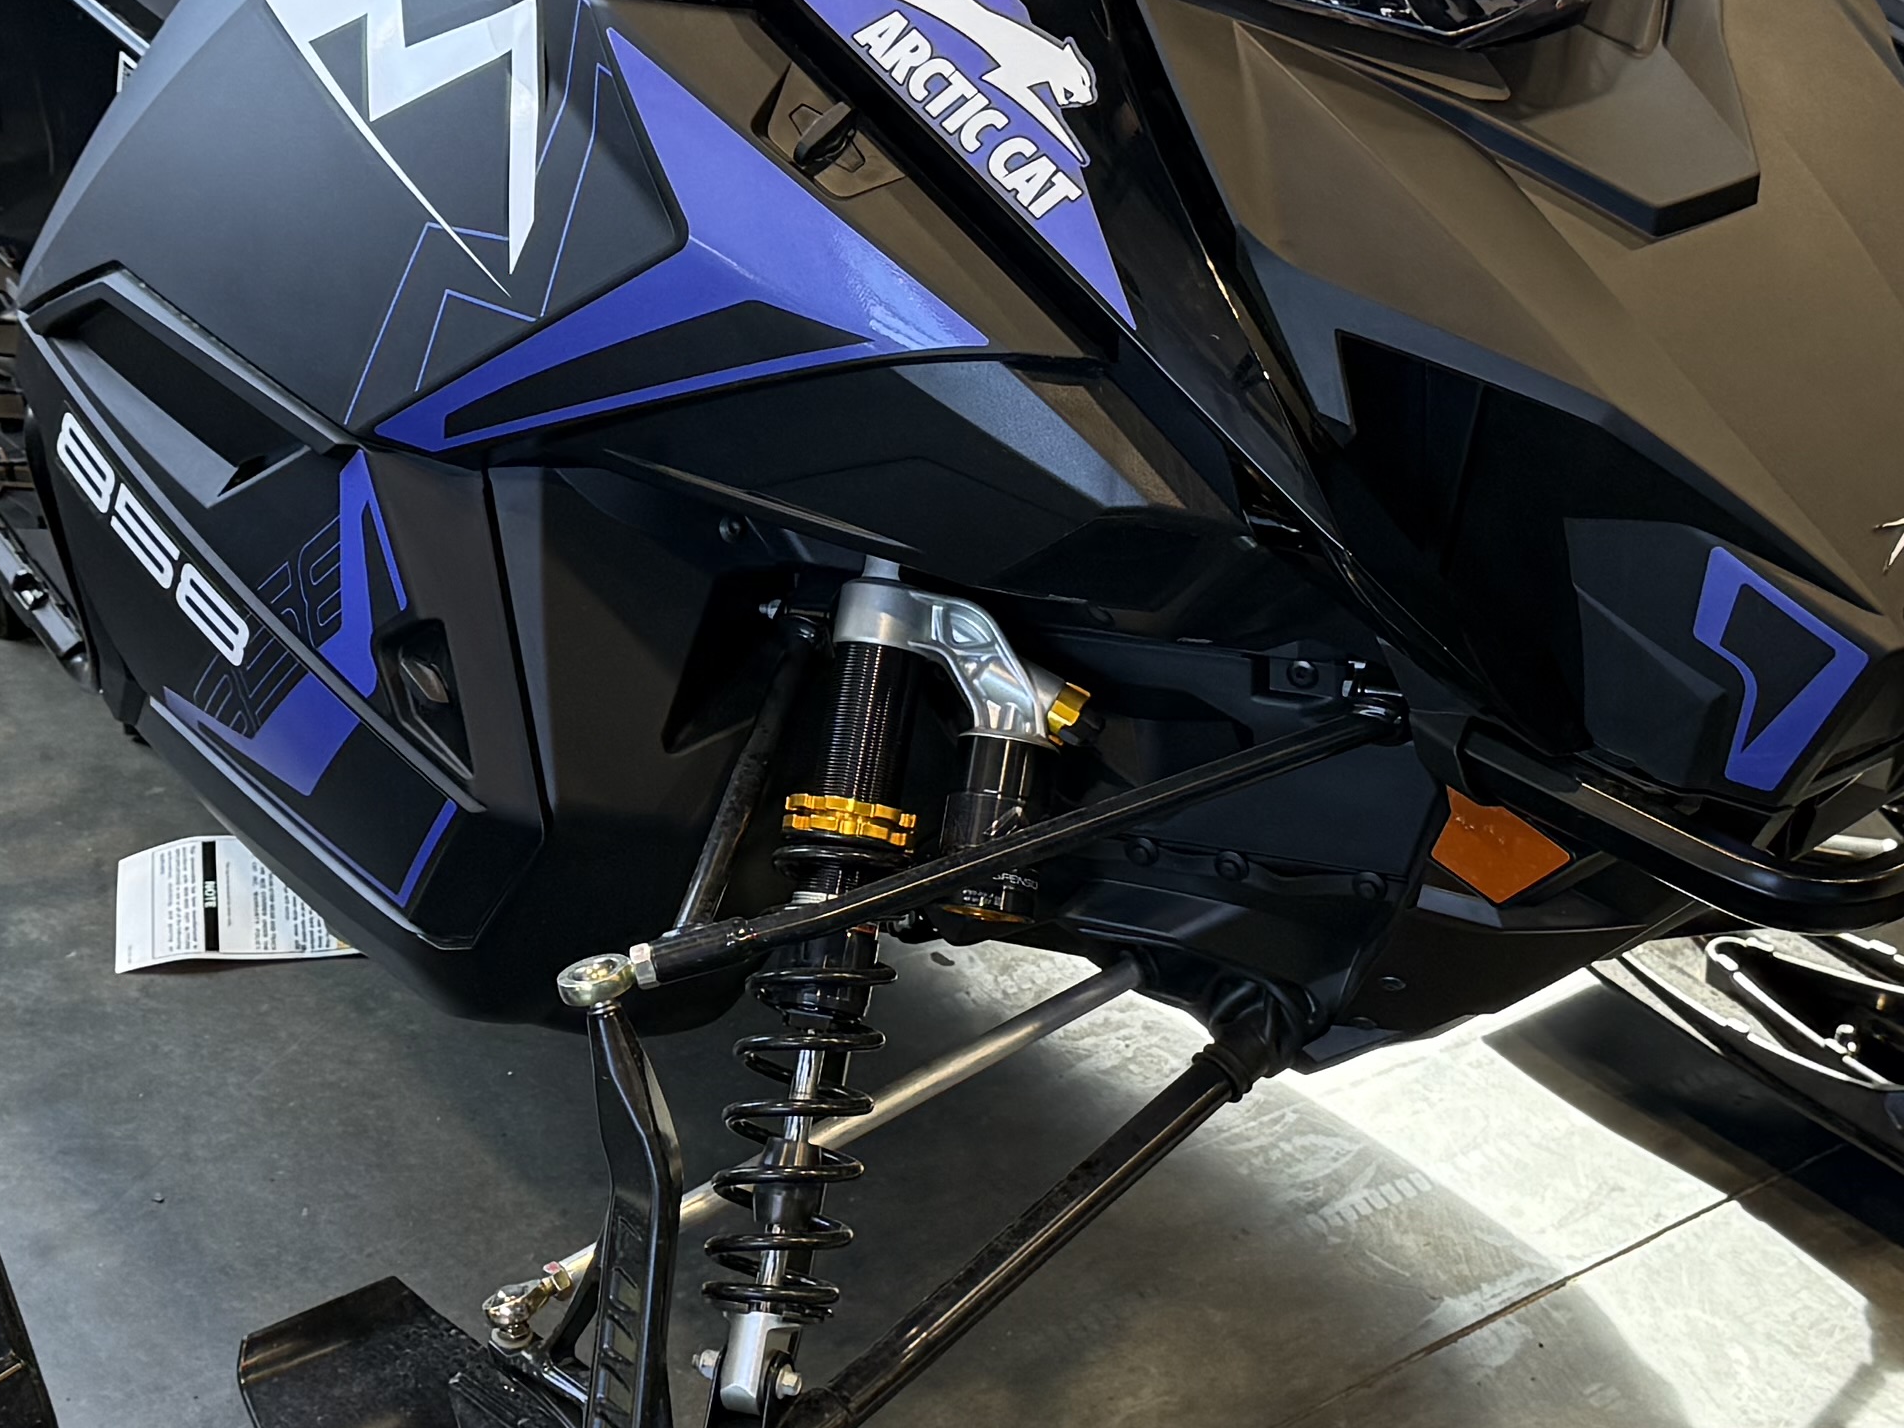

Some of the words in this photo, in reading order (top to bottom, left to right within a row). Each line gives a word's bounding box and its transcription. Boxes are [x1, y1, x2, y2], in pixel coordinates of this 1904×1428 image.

[852, 9, 1007, 154] ARCTIC
[986, 132, 1084, 221] CAT
[56, 411, 250, 667] 858
[204, 880, 217, 908] NOTE
